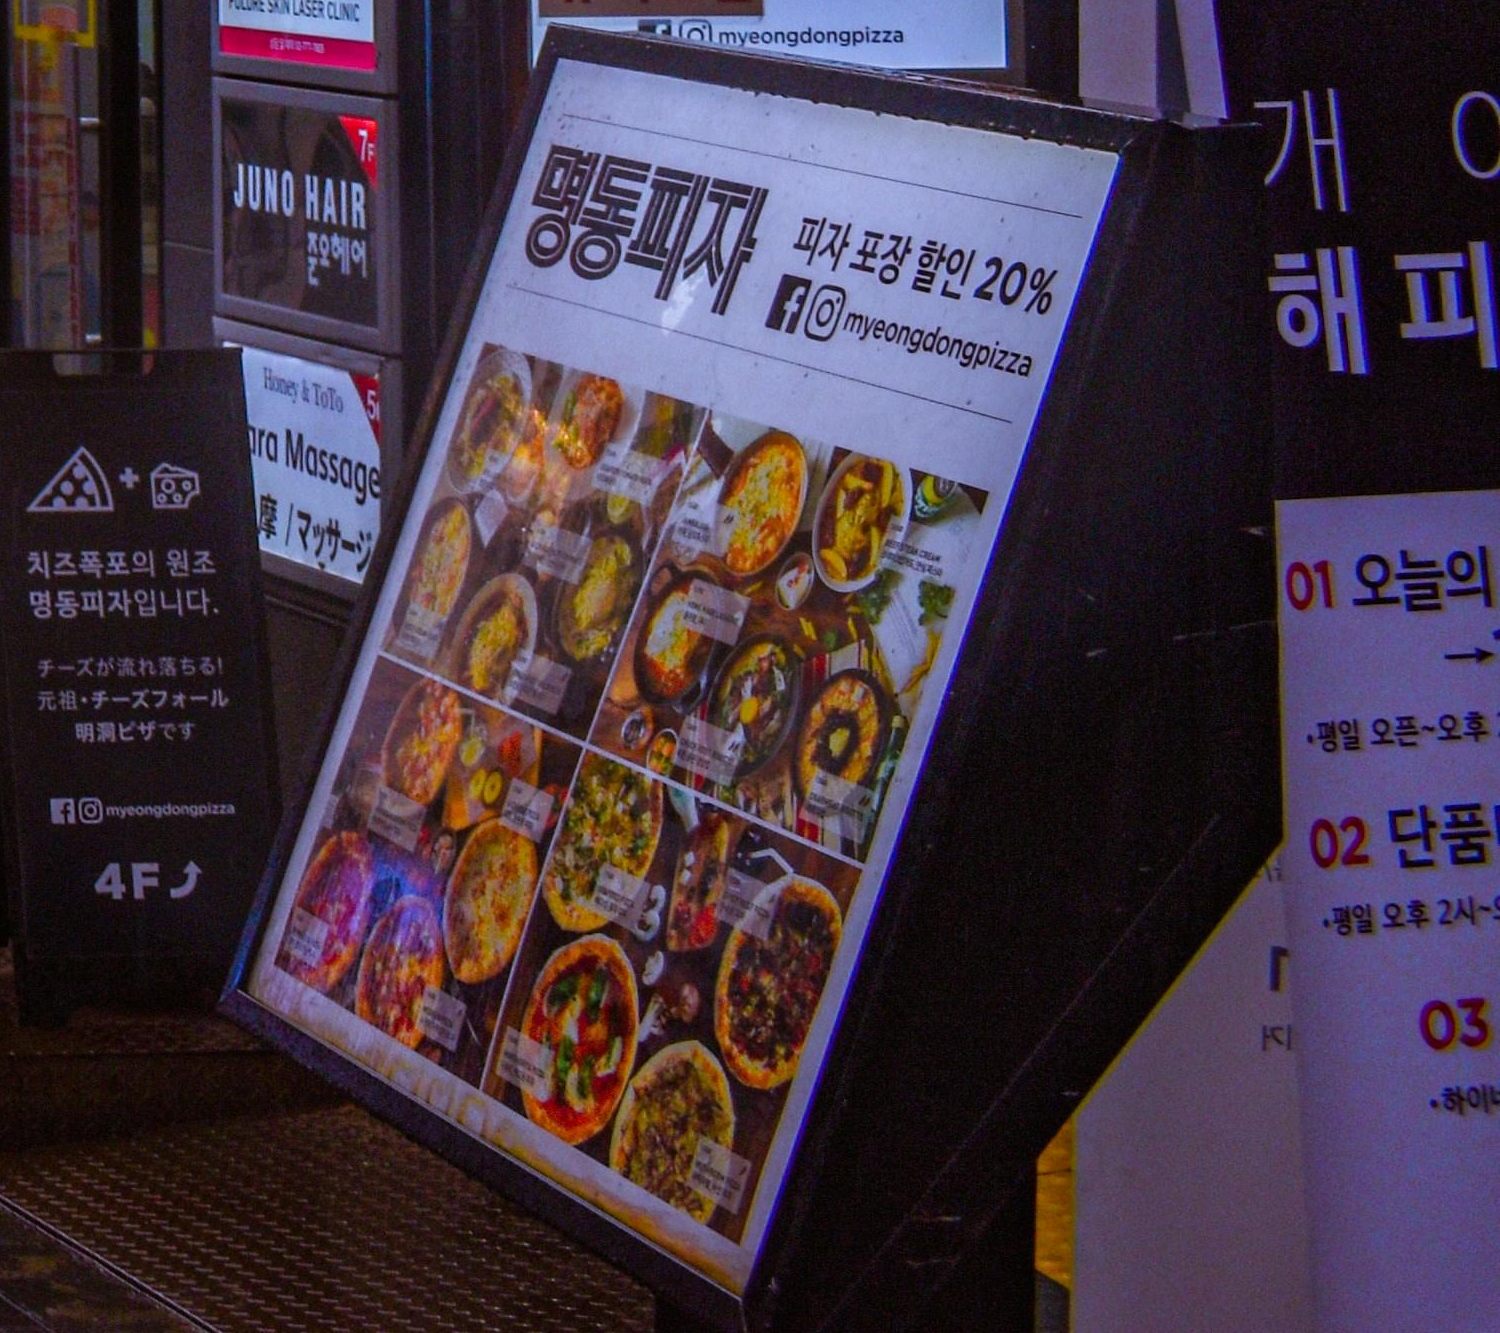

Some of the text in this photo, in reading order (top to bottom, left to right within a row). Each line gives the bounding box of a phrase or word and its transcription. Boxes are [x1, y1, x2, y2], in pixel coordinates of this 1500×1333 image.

[717, 24, 904, 49] myeongdongpizza
[233, 163, 368, 232] JUNO HAIR
[523, 143, 769, 317] 명동피자
[793, 215, 1060, 316] 피자 포장 할인 20%
[842, 308, 1034, 378] myeongdongpizza
[26, 549, 155, 579] 치즈폭포의
[1285, 544, 1493, 613] 01 오늘의
[27, 587, 220, 619] 명동피자입니다.
[105, 800, 236, 820] myeongdongpizza
[1309, 815, 1371, 869] 02
[93, 862, 162, 902] 4F
[1419, 997, 1490, 1052] 03
